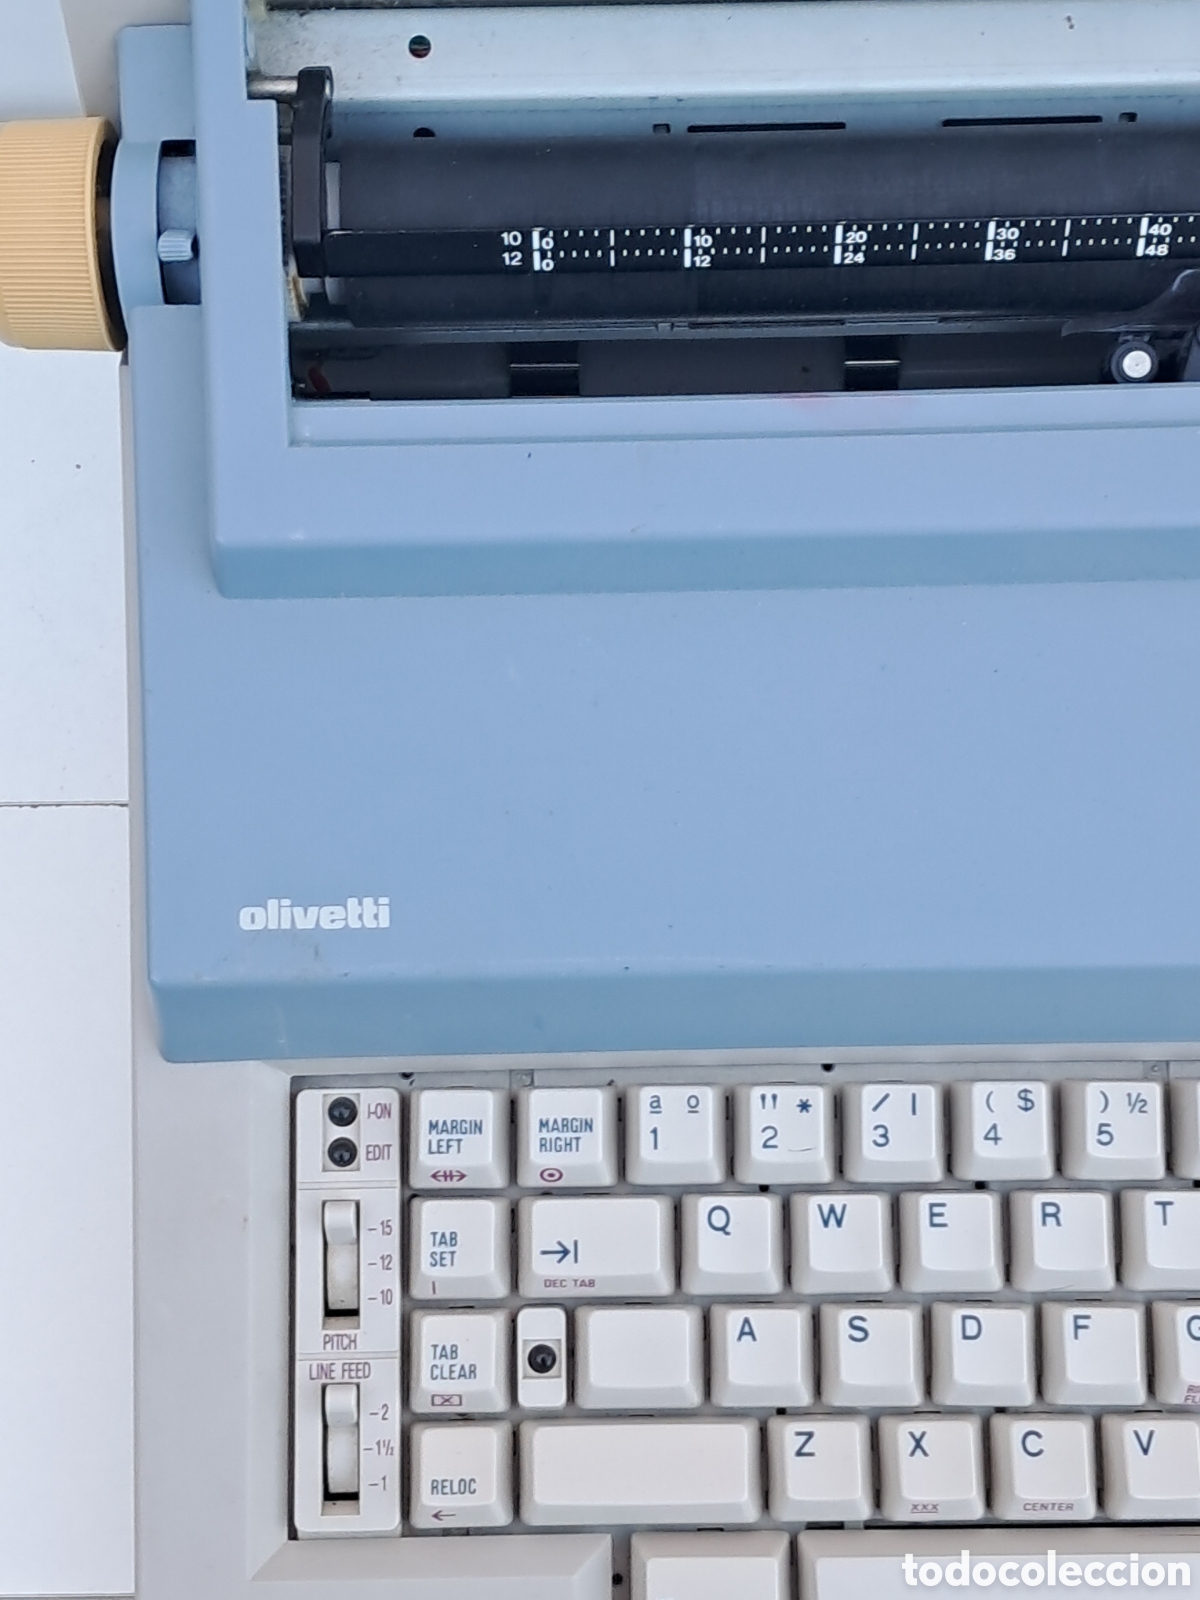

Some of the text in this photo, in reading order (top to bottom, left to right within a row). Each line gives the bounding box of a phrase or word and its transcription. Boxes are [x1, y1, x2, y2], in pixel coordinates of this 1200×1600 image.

[501, 223, 1173, 250] 10 0 10 20 30 40
[501, 244, 1169, 271] 12 0 12 24 36 48
[239, 896, 390, 931] olivetti
[1017, 1088, 1035, 1113] $
[428, 1119, 483, 1135] MARGIN
[538, 1117, 594, 1134] MARGIN
[760, 1125, 779, 1149] 2
[872, 1124, 890, 1148] 3
[983, 1122, 1003, 1146] 4
[1096, 1122, 1115, 1147] 5
[365, 1143, 393, 1162] EDIT
[427, 1138, 464, 1155] LEFT
[539, 1136, 582, 1153] RIGHT
[707, 1205, 732, 1236] Q
[817, 1203, 847, 1229] W
[928, 1202, 949, 1228] E
[1041, 1201, 1062, 1227] R
[1154, 1200, 1175, 1227] T
[430, 1231, 458, 1248] TAB
[429, 1250, 457, 1268] SET
[543, 1278, 596, 1289] DEC TAB
[736, 1316, 757, 1342] A
[848, 1315, 870, 1343] S
[961, 1314, 983, 1341] D
[1072, 1314, 1092, 1341] F
[322, 1333, 358, 1351] PITCH
[430, 1343, 459, 1361] TAB
[308, 1361, 371, 1381] LINE FEED
[430, 1363, 477, 1381] CLEAR
[794, 1430, 816, 1458] Z
[908, 1430, 929, 1458] X
[1021, 1429, 1045, 1458] C
[1133, 1429, 1155, 1456] V
[430, 1477, 477, 1496] RELOC
[1022, 1502, 1075, 1512] CENTER
